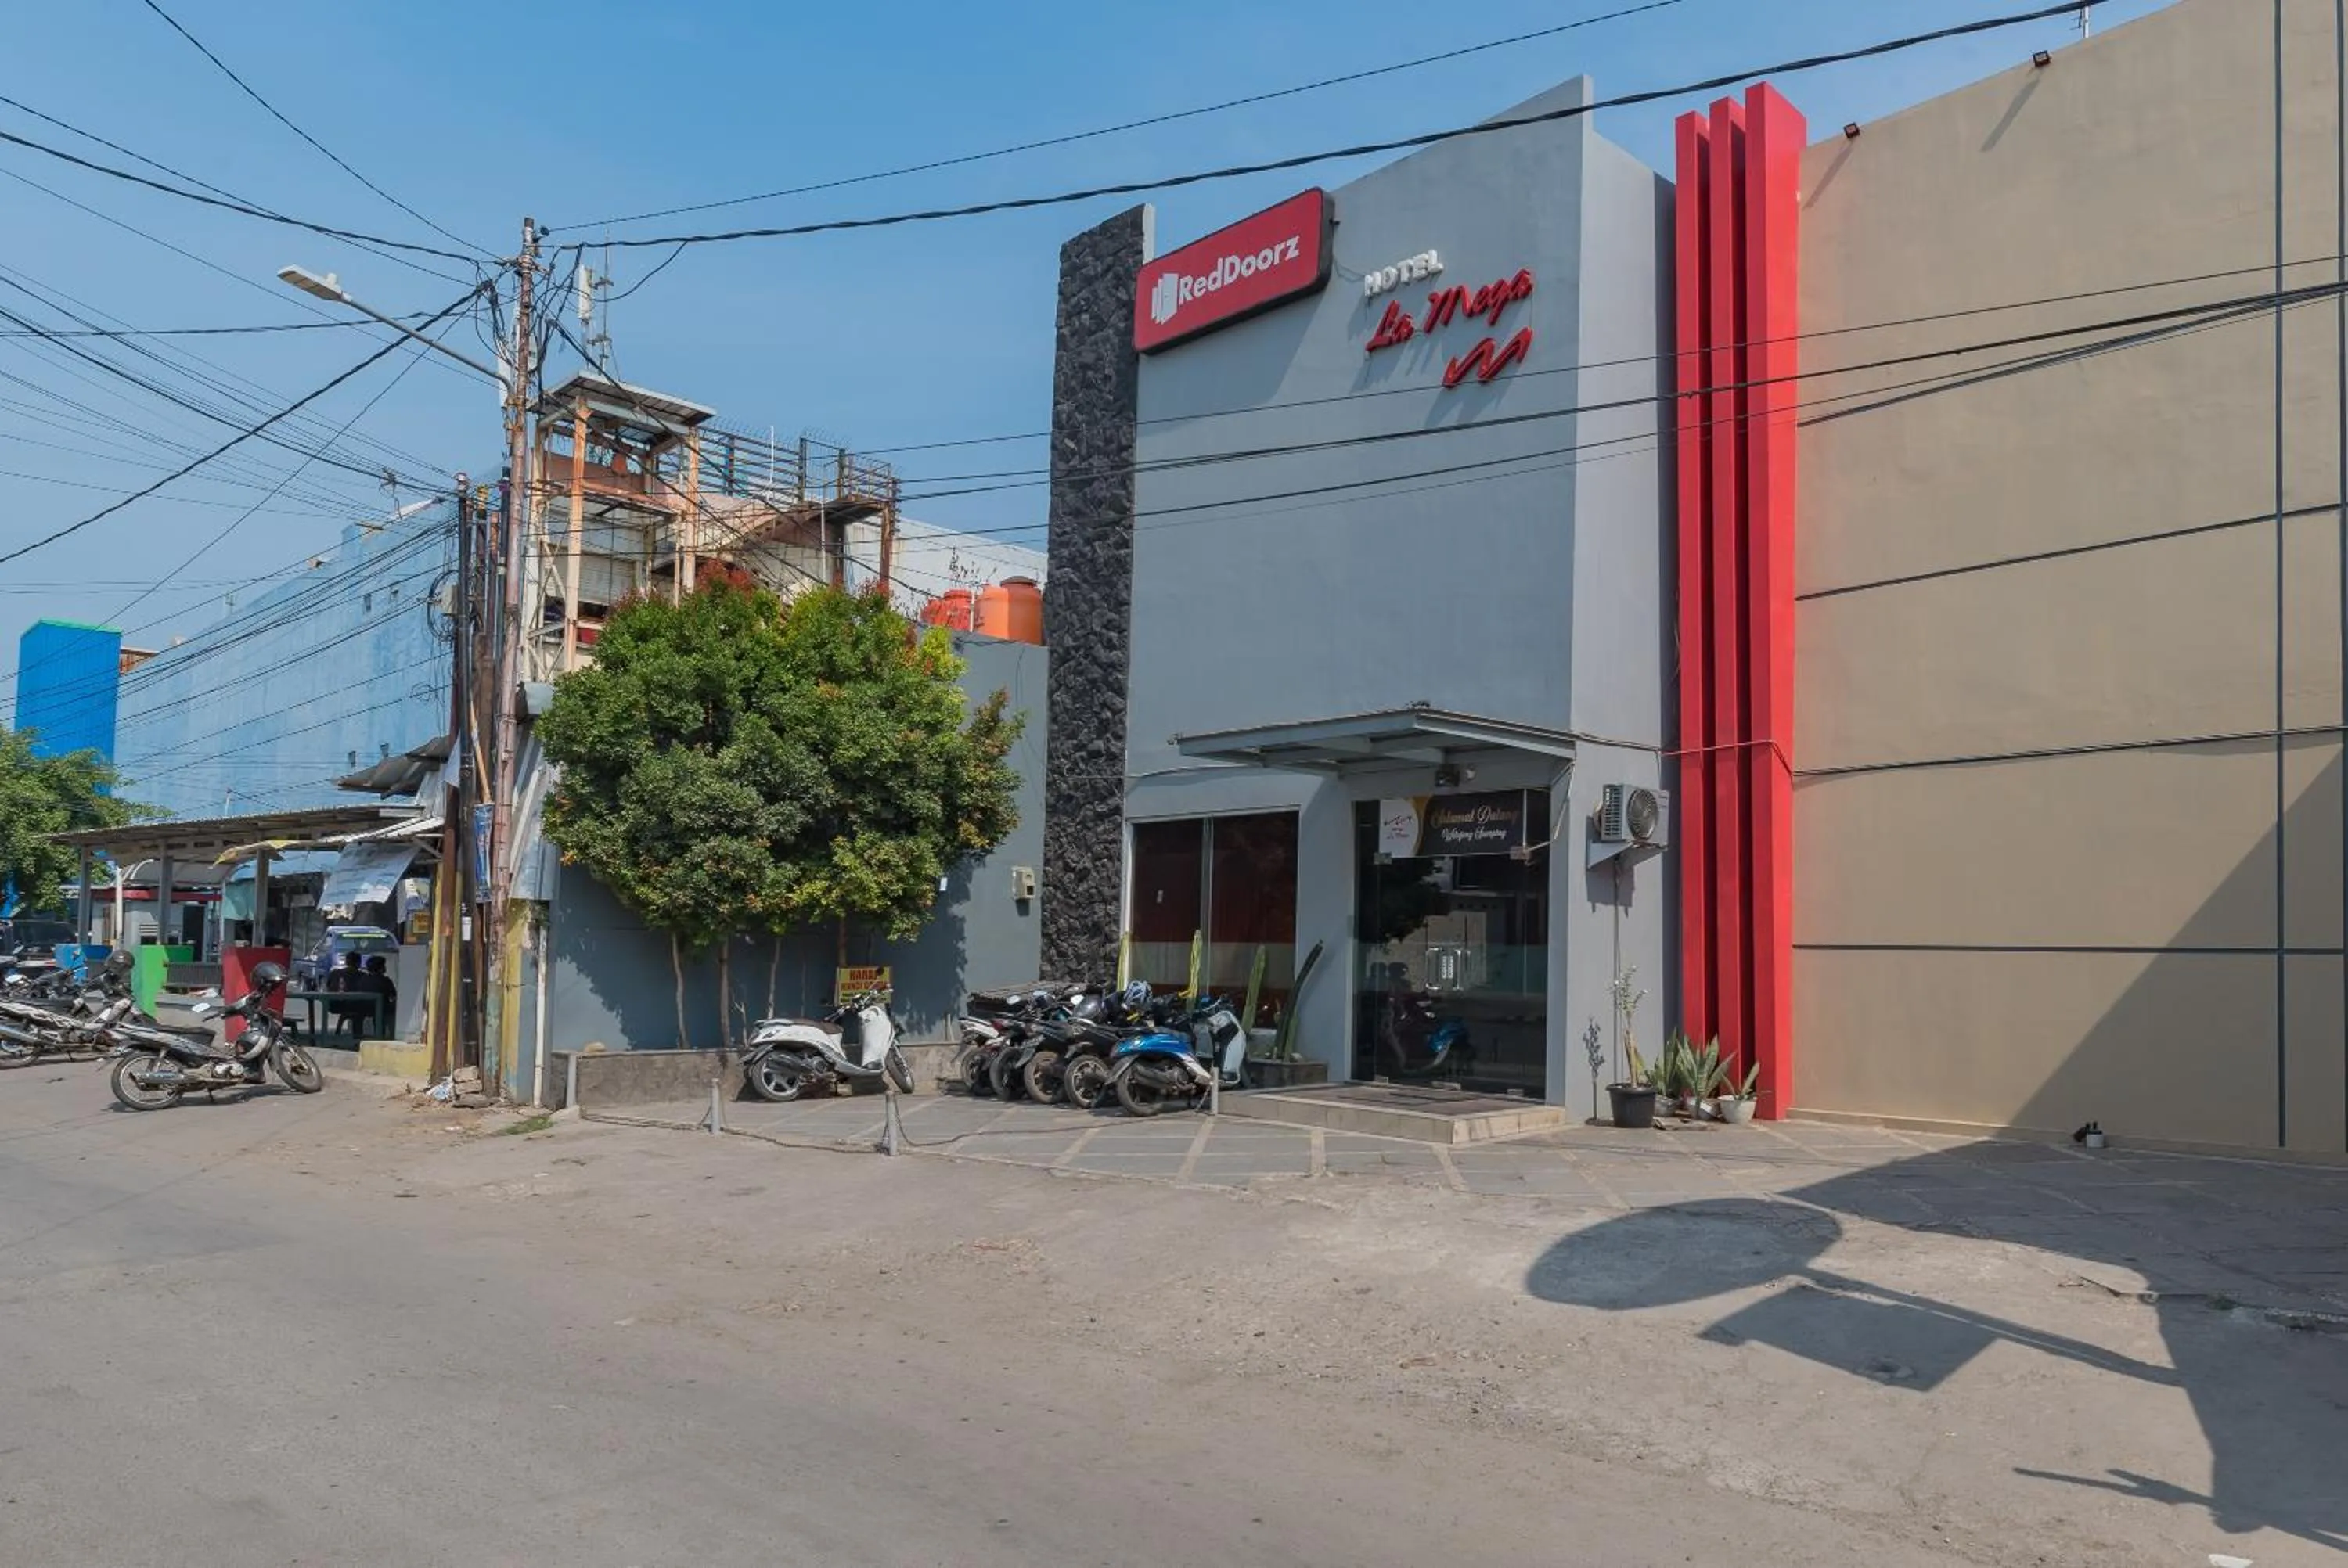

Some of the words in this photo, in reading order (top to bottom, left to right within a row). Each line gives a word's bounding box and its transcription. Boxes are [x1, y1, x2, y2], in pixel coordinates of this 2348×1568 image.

[1178, 236, 1300, 307] RedDoorz
[1364, 250, 1444, 297] HOTEL
[1365, 300, 1415, 351] La
[1423, 268, 1534, 335] Mega
[1477, 804, 1518, 826] Datang
